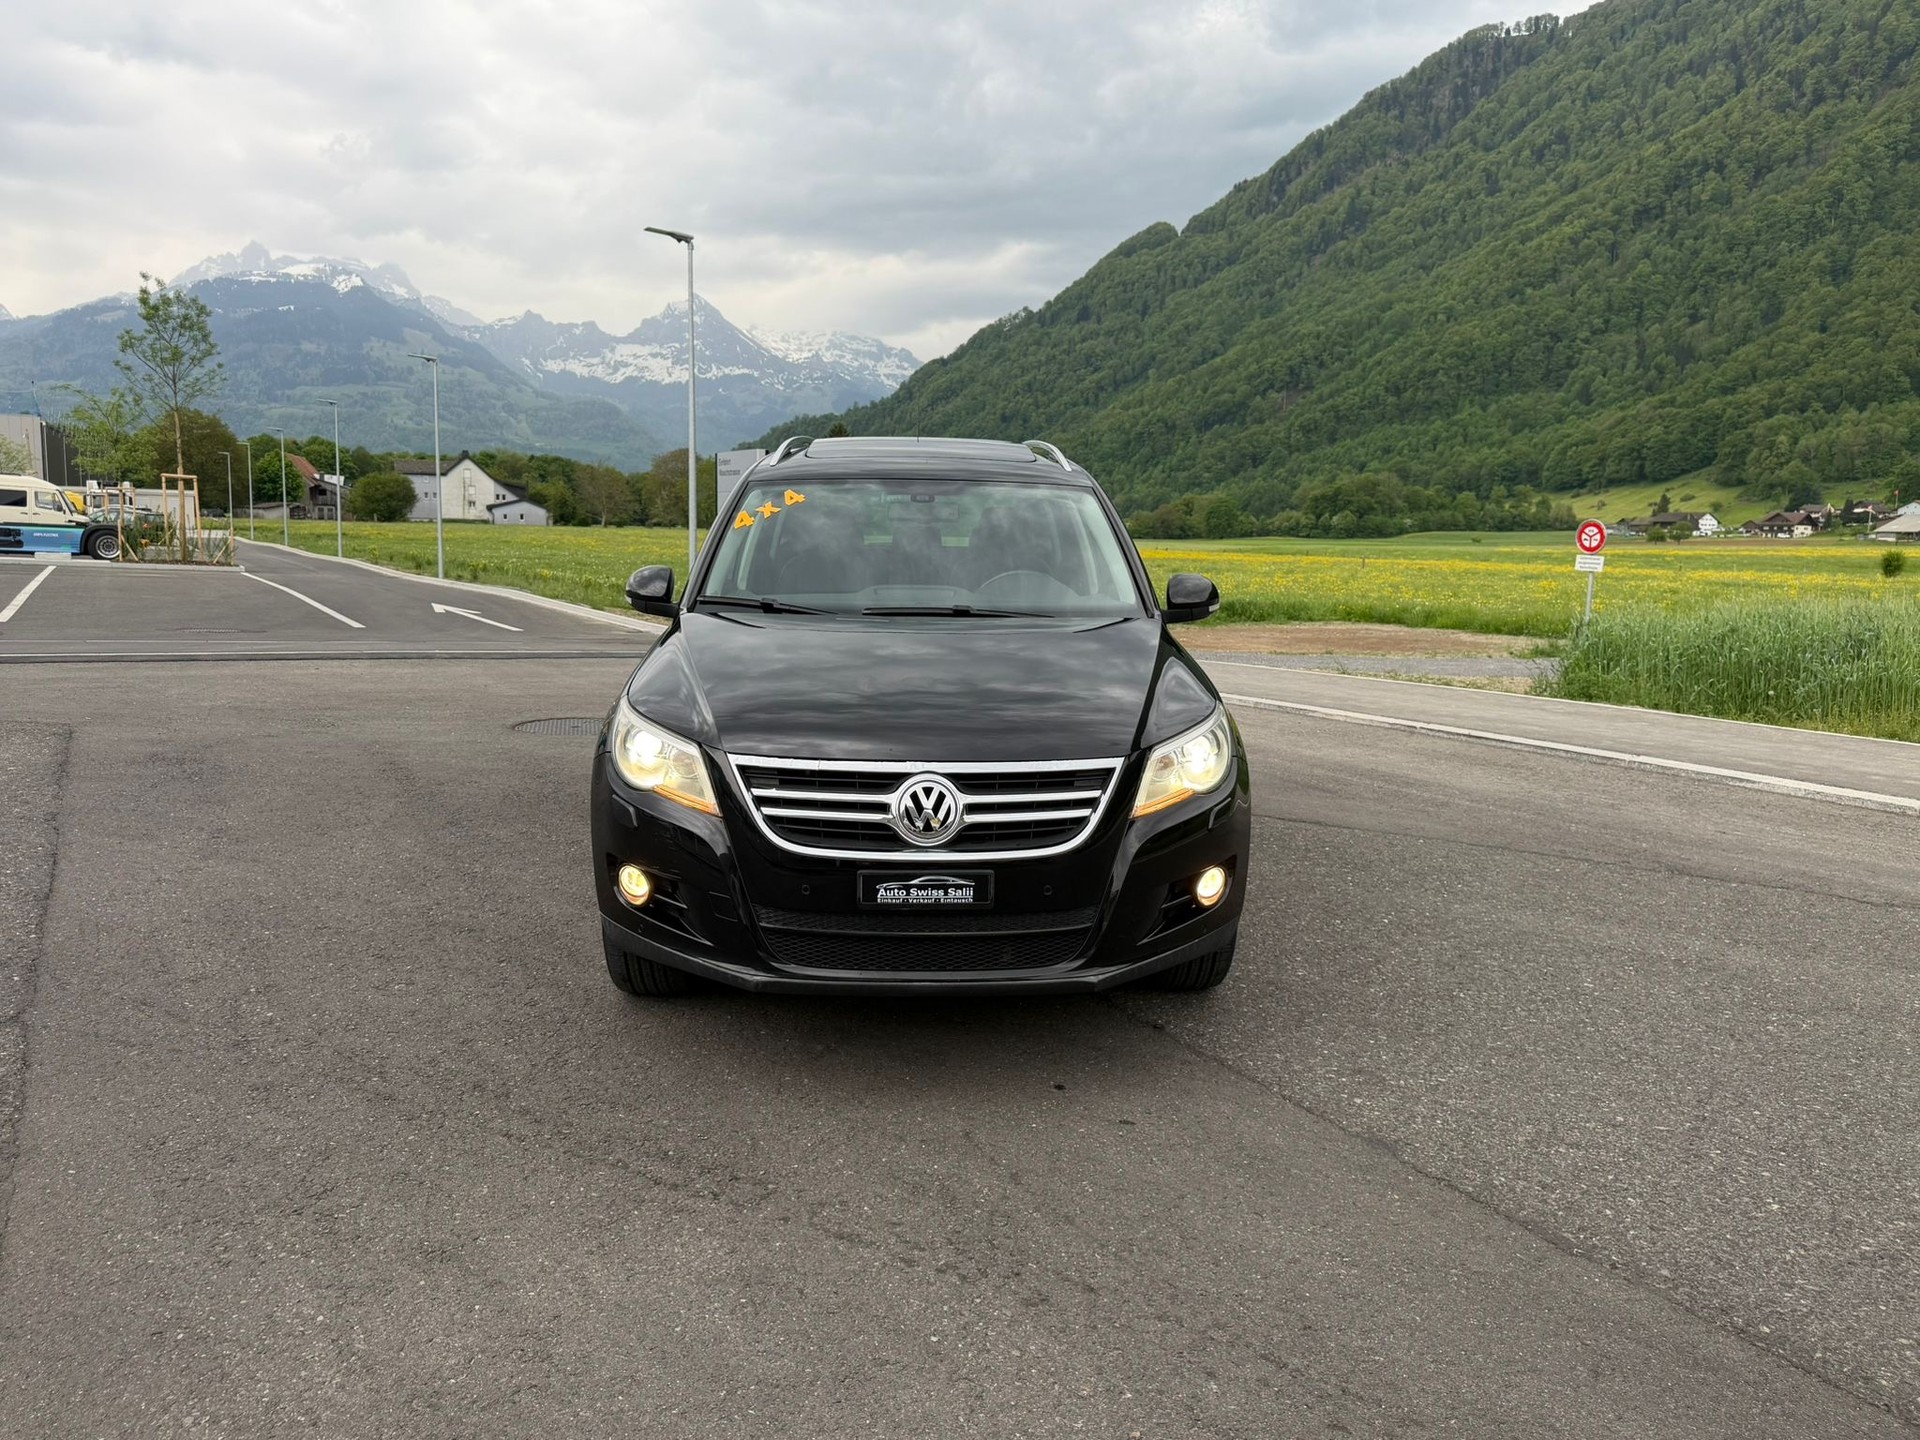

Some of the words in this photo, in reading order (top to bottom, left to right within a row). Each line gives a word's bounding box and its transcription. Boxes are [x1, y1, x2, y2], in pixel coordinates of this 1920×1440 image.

[903, 780, 952, 834] VW
[877, 887, 907, 898] Auto
[909, 887, 944, 897] Swiss
[948, 887, 974, 897] Salii
